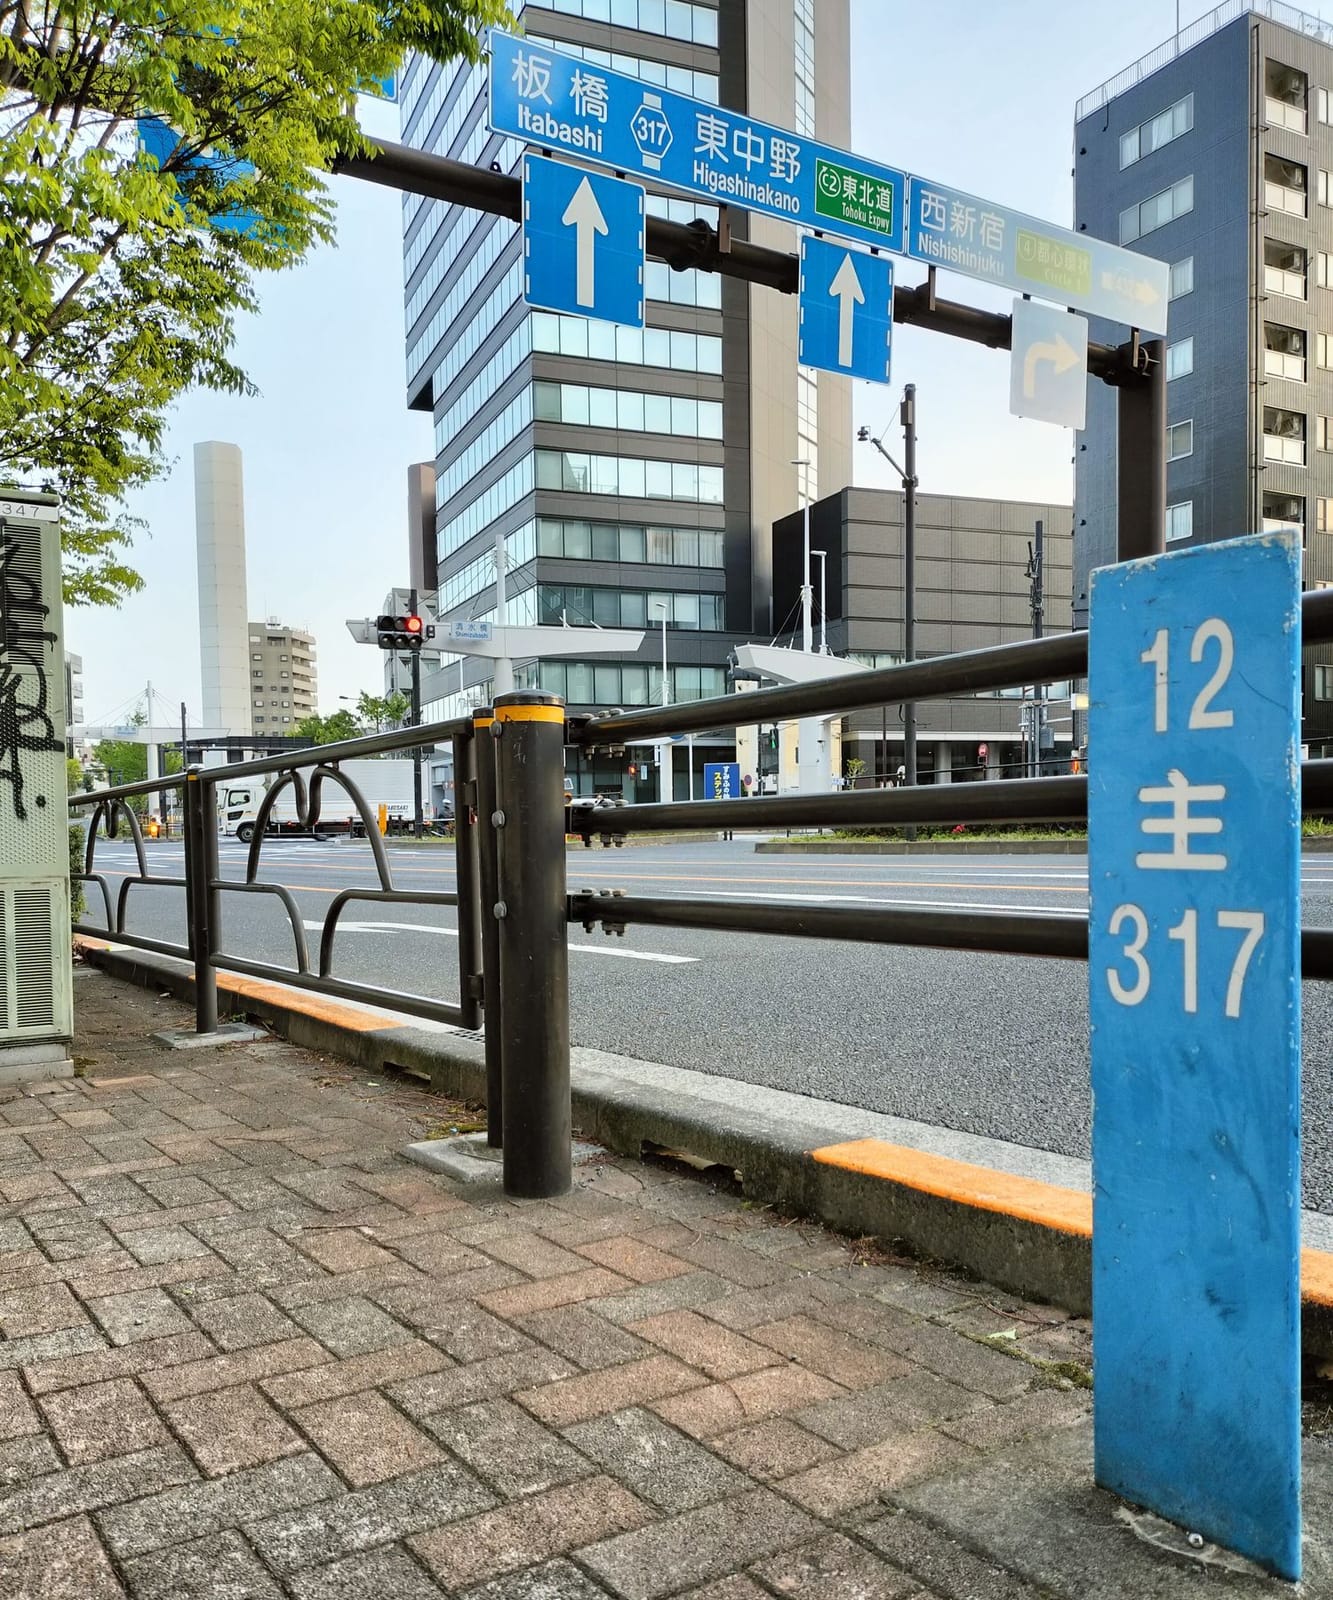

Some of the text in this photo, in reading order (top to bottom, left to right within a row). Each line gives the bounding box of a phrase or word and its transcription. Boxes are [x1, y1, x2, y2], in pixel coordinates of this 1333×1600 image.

[511, 48, 609, 124] 板橋
[517, 104, 603, 154] Itabashi
[636, 116, 666, 148] 317
[693, 112, 801, 184] 東中野
[693, 158, 800, 214] Higashinakano
[822, 173, 891, 213] C2 東北道
[842, 202, 890, 233] Tohoku Expwy
[919, 189, 1005, 250] 西新宿
[918, 231, 1005, 277] Nishishinjuku
[2, 503, 40, 518] 347
[1140, 617, 1234, 733] 12
[1135, 768, 1228, 871] 主
[1106, 903, 1265, 1018] 317
